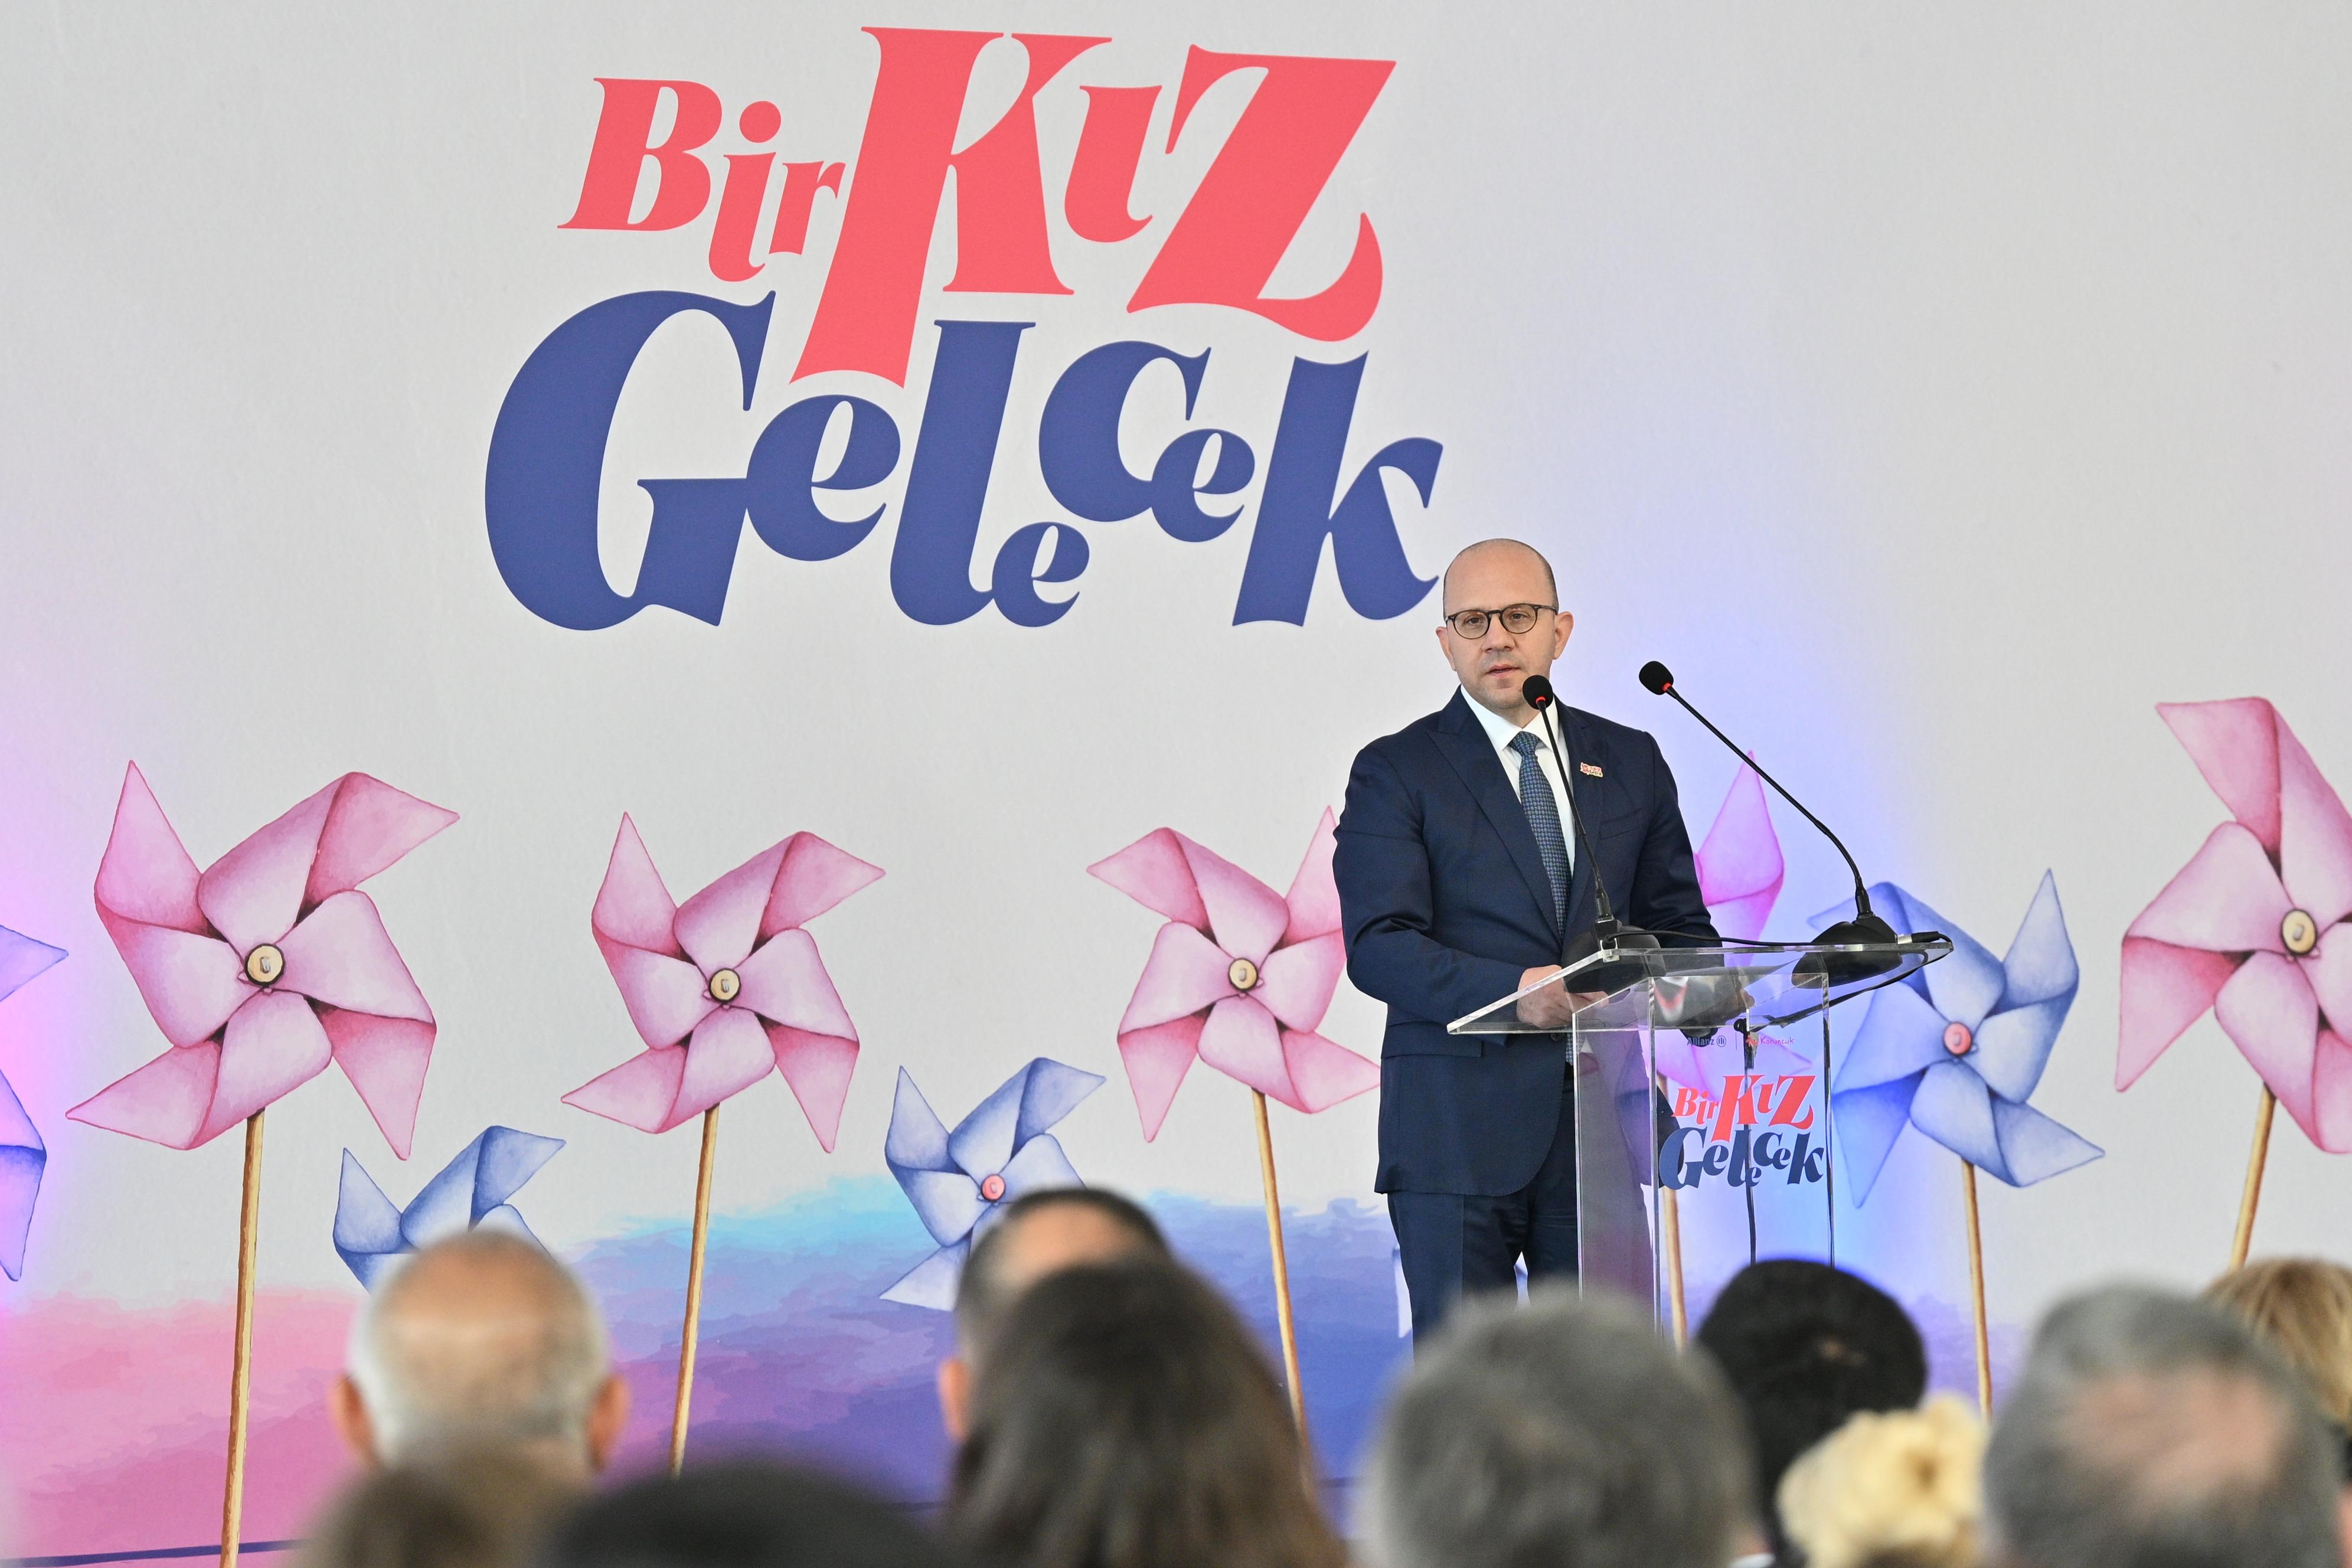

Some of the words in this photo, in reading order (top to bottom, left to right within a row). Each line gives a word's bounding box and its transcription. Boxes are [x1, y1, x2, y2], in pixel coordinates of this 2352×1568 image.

[558, 77, 847, 283] Bir
[485, 290, 1444, 631] Gelecek
[1687, 1037, 1715, 1046] Allianz
[1760, 1036, 1795, 1045] Koruncuk
[1671, 1087, 1720, 1125] Bir
[1659, 1126, 1825, 1190] Gelecek
